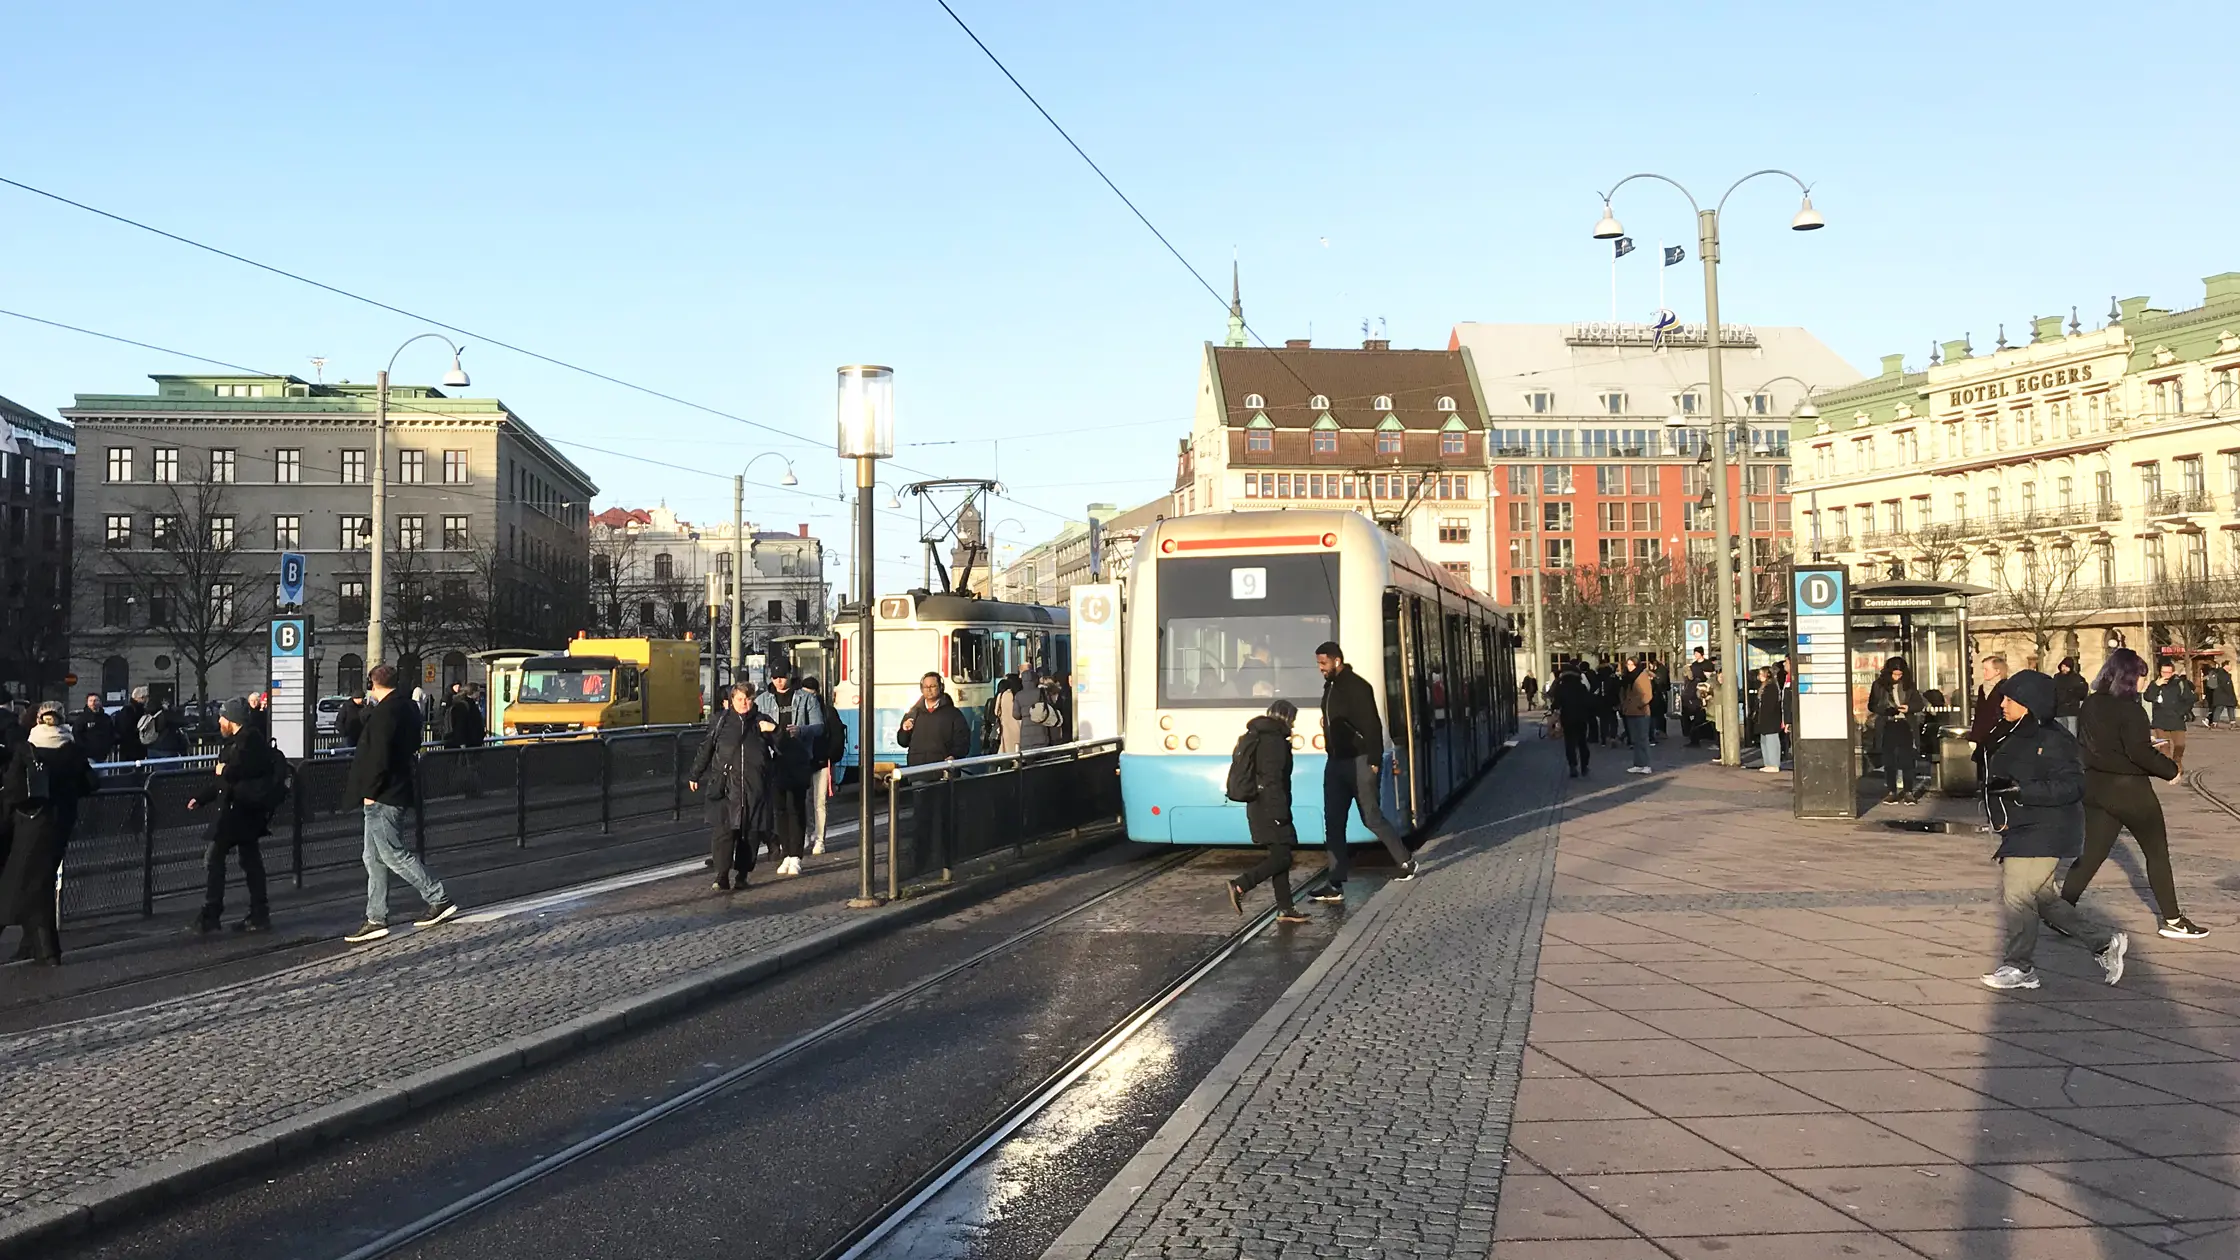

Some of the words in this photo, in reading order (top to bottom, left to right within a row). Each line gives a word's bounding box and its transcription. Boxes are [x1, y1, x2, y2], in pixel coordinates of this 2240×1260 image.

[1572, 321, 1644, 336] HOTEL
[1683, 323, 1757, 338] OPRA
[1950, 381, 2009, 407] HOTEL
[2016, 364, 2093, 395] EGGERS
[288, 562, 298, 582] B
[1243, 573, 1256, 595] 9
[1811, 579, 1829, 603] D
[890, 600, 901, 618] 7
[1088, 600, 1102, 621] C
[1864, 598, 1932, 607] Centralstationen
[282, 627, 294, 647] B
